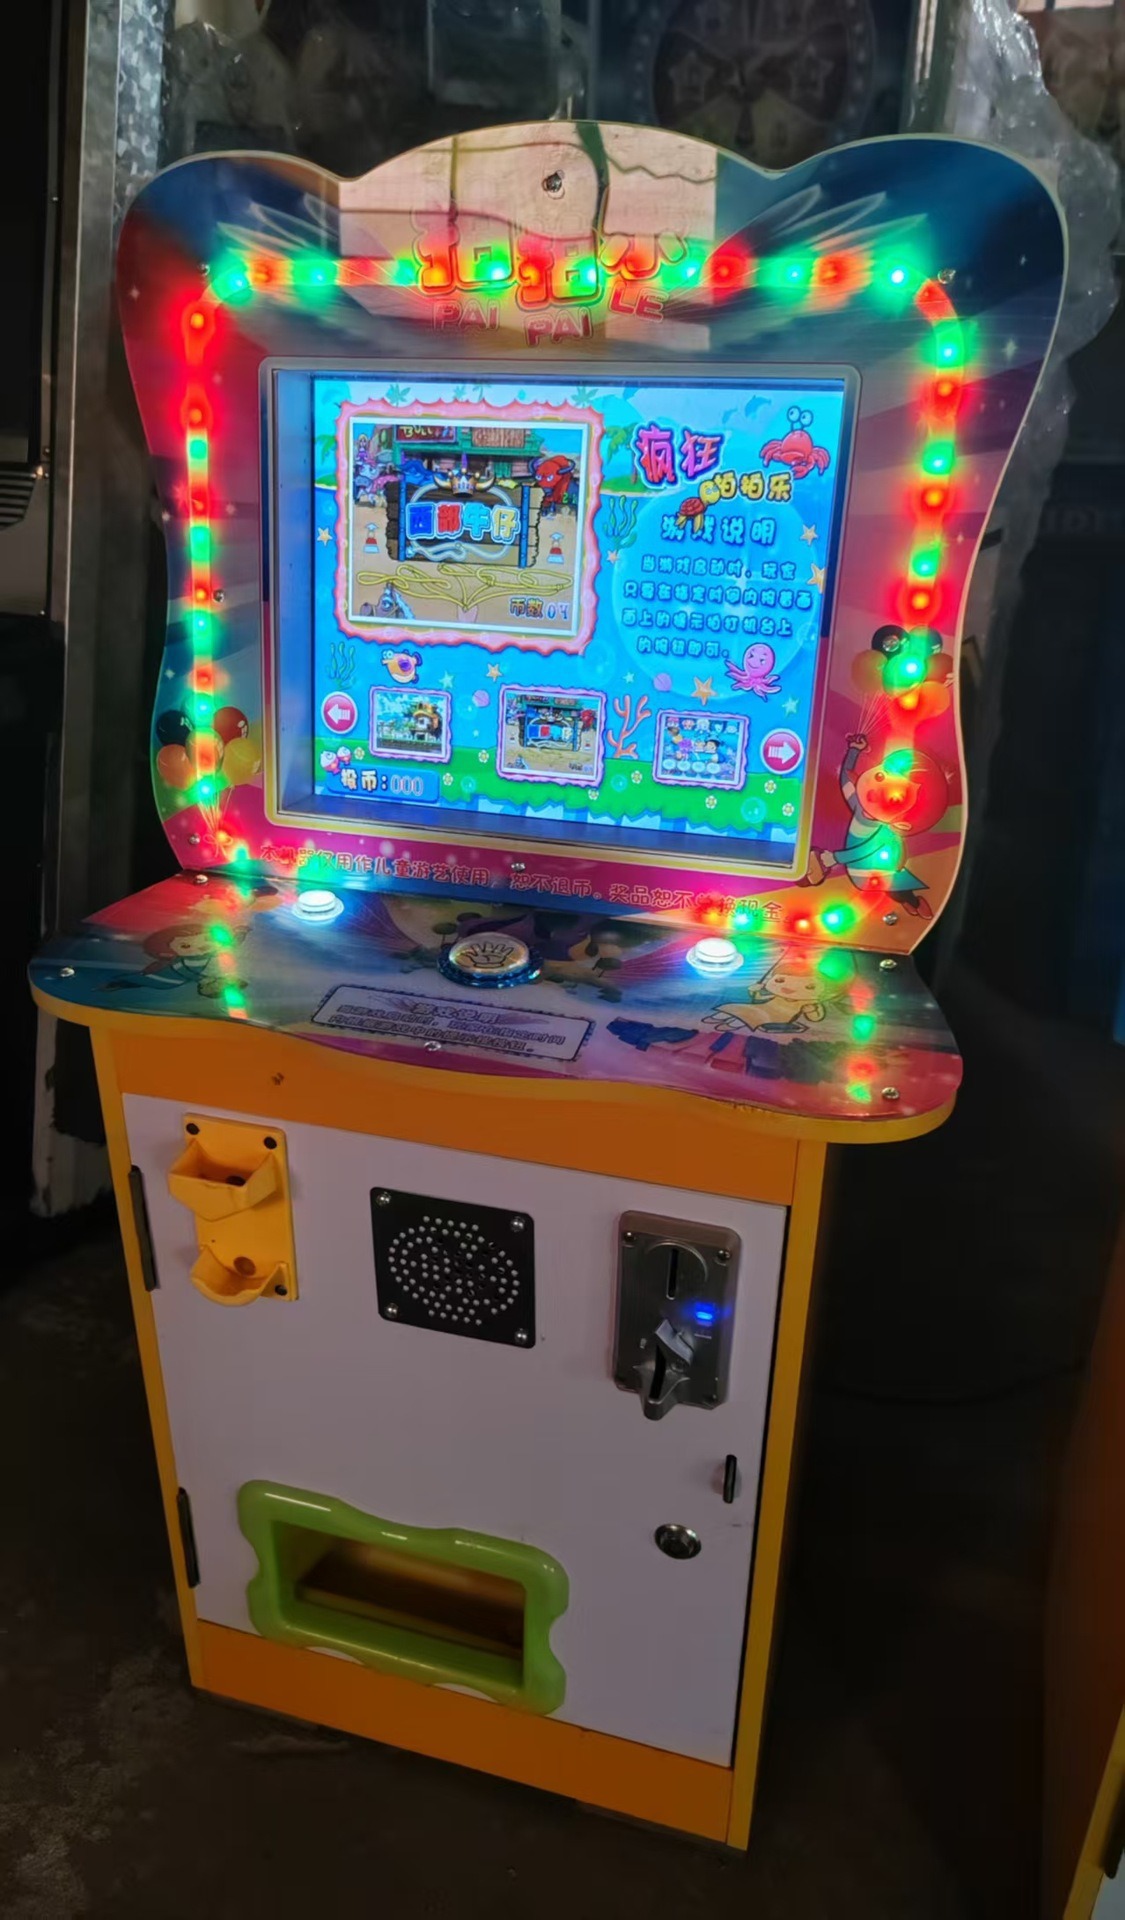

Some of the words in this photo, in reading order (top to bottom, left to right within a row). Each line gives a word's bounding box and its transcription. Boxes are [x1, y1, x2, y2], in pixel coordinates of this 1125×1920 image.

[433, 299, 499, 335] PAI
[522, 306, 593, 348] PAI
[609, 282, 669, 322] LE
[636, 422, 724, 487] 疯狂
[712, 470, 793, 503] 拍拍乐
[405, 501, 521, 544] 西部牛仔
[661, 514, 777, 546] 游戏说明
[509, 597, 545, 619] 币数
